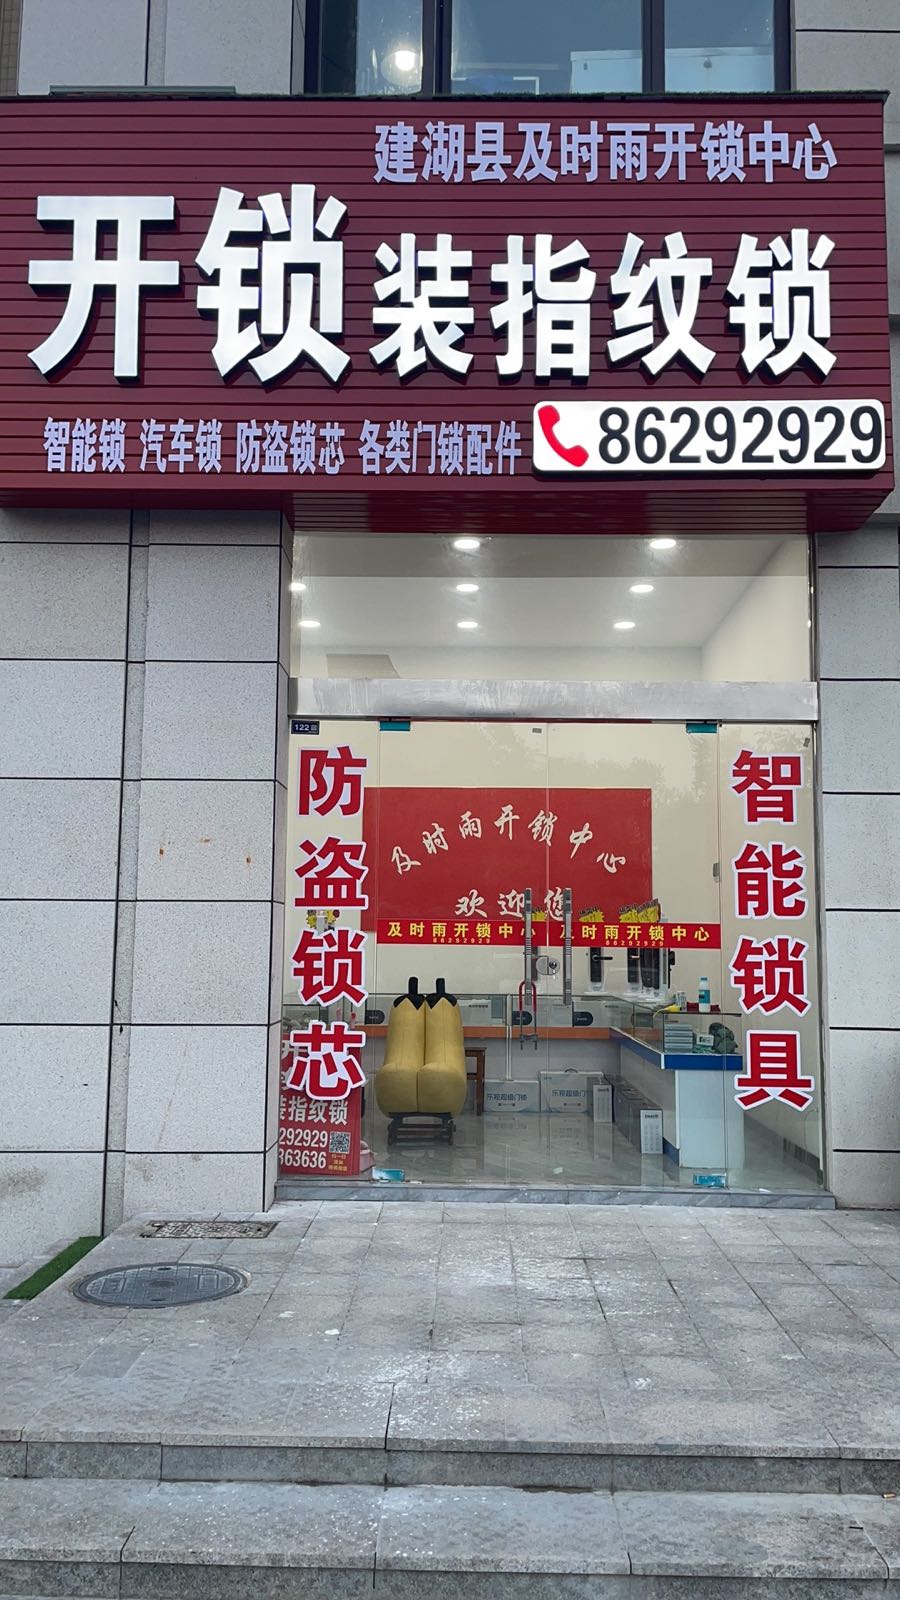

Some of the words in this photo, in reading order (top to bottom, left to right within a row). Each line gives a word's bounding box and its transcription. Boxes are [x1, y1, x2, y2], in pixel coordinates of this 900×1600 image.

[373, 120, 838, 183] 建湖县及时雨开锁中心
[27, 183, 837, 385] 开锁装指纹锁
[43, 416, 126, 474] 智能锁
[139, 418, 223, 475] 汽车锁
[235, 419, 346, 475] 防盗锁芯
[357, 418, 522, 476] 各类门锁配件
[599, 406, 883, 464] 86292929
[391, 804, 626, 875] 及时雨开锁中心
[291, 745, 368, 1100] 防盗锁芯
[732, 749, 814, 1112] 智能锁具
